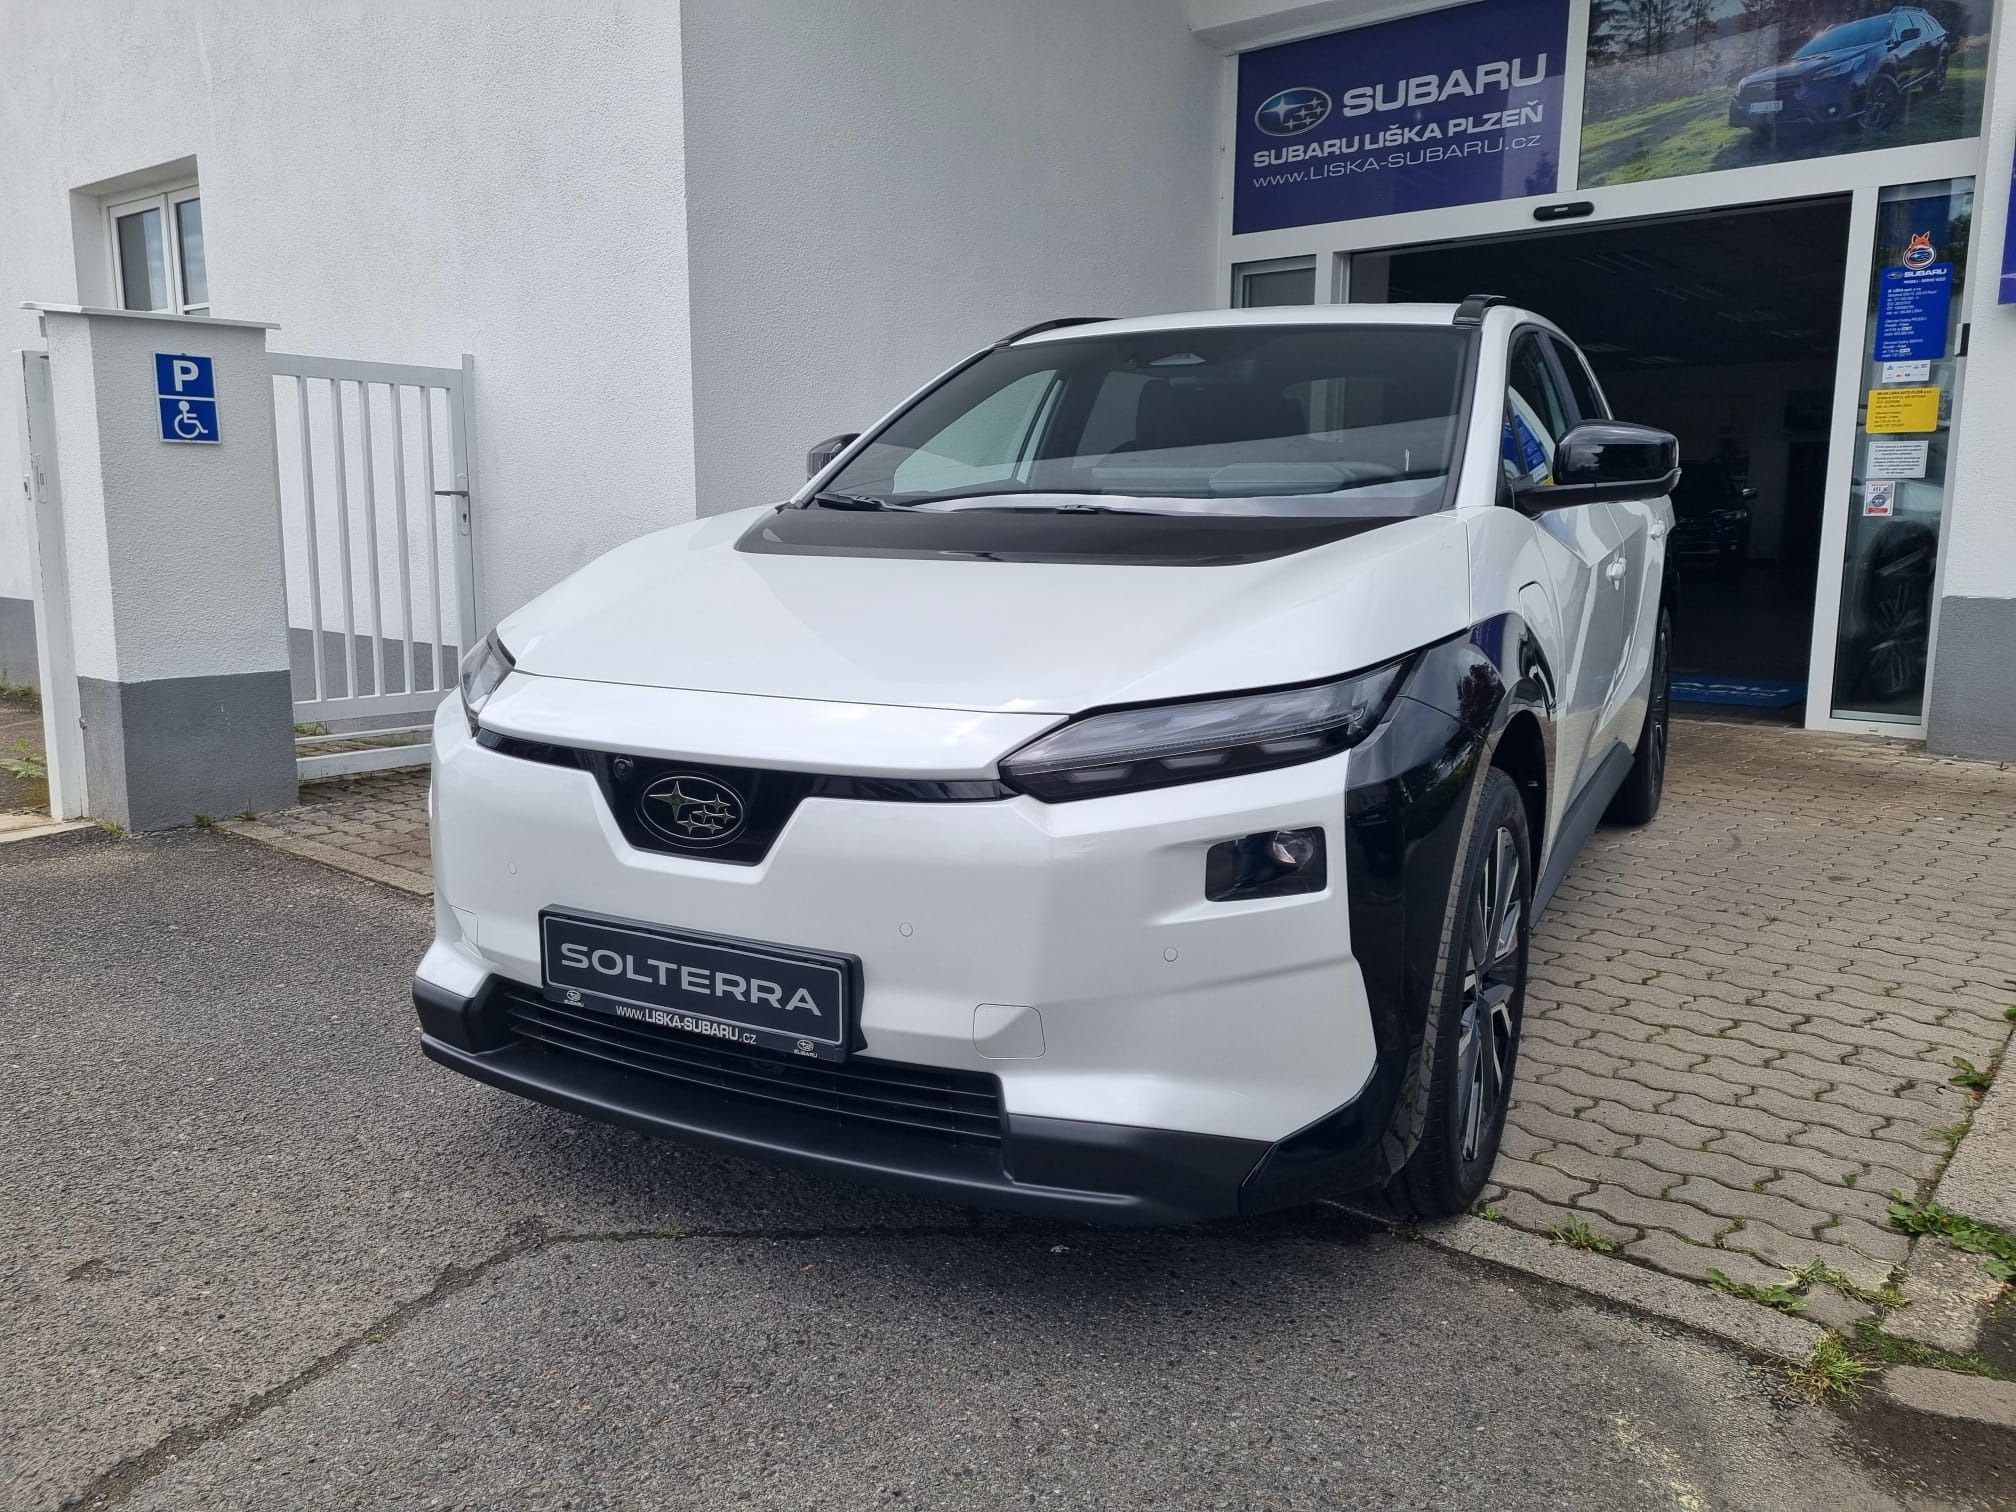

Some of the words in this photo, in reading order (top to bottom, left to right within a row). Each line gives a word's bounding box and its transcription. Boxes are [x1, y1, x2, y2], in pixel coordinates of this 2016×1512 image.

[1342, 53, 1547, 117] SUBARU
[1253, 136, 1360, 167] SUBARU
[1365, 124, 1442, 150] LIŠKA
[1448, 100, 1544, 137] PLZEŇ
[1253, 135, 1542, 188] www.LISKA-SUBARU.cz
[1903, 268, 1947, 278] SUBARU
[173, 359, 199, 392] P
[560, 943, 822, 1017] SOLTERRA
[616, 1005, 757, 1046] www.LISKA-SUBARU.cz
[793, 1049, 818, 1058] SUBARU
